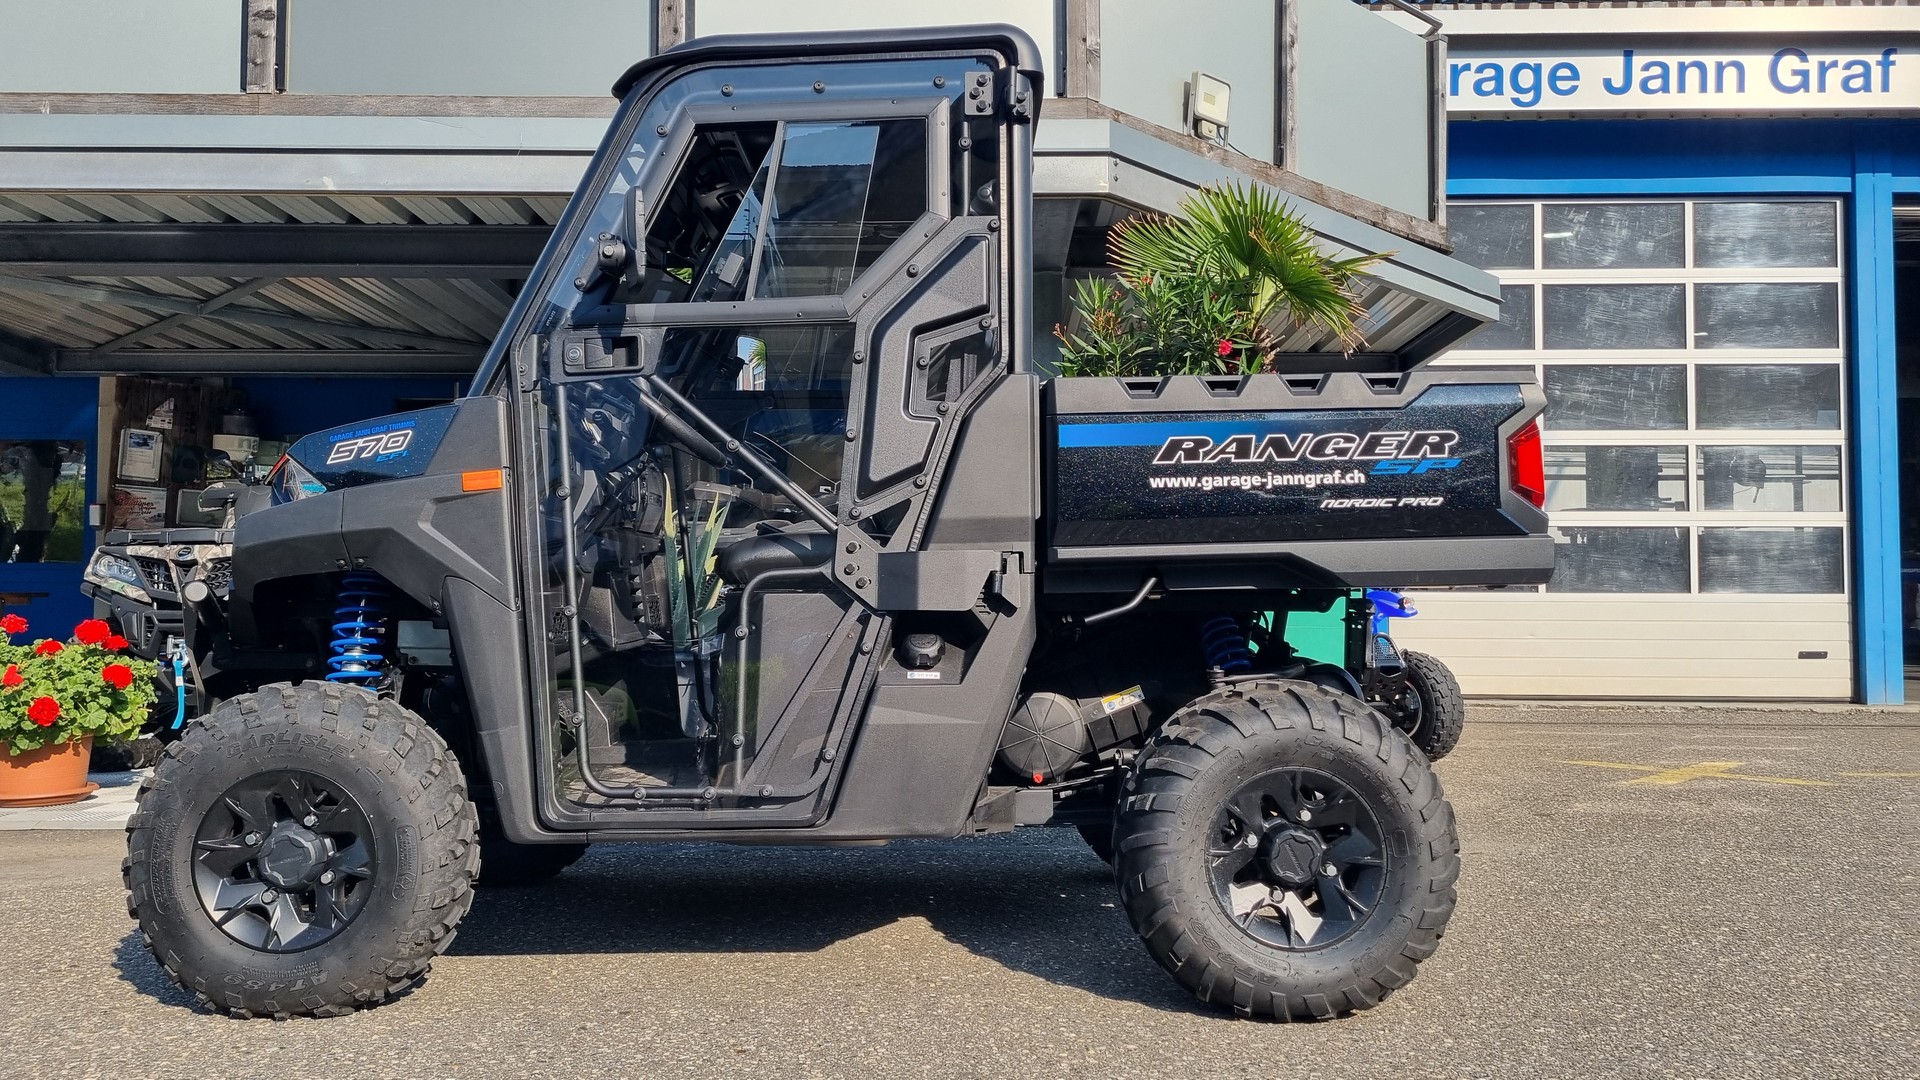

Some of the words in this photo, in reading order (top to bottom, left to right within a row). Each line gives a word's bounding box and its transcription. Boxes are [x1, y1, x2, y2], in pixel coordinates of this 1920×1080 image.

[1602, 49, 1746, 96] Jann
[1767, 47, 1898, 95] Graf
[330, 432, 354, 442] GARAGE
[355, 428, 371, 437] JANN
[326, 431, 413, 464] 570
[375, 450, 409, 462] EFI
[1152, 429, 1460, 464] RANGER
[1369, 458, 1462, 475] SP
[1149, 471, 1366, 489] www.garage-janngraf.ch
[1320, 497, 1395, 509] NORDIC
[1398, 496, 1445, 507] PRO
[226, 732, 350, 758] CARLISLE
[223, 970, 330, 992] AT489
